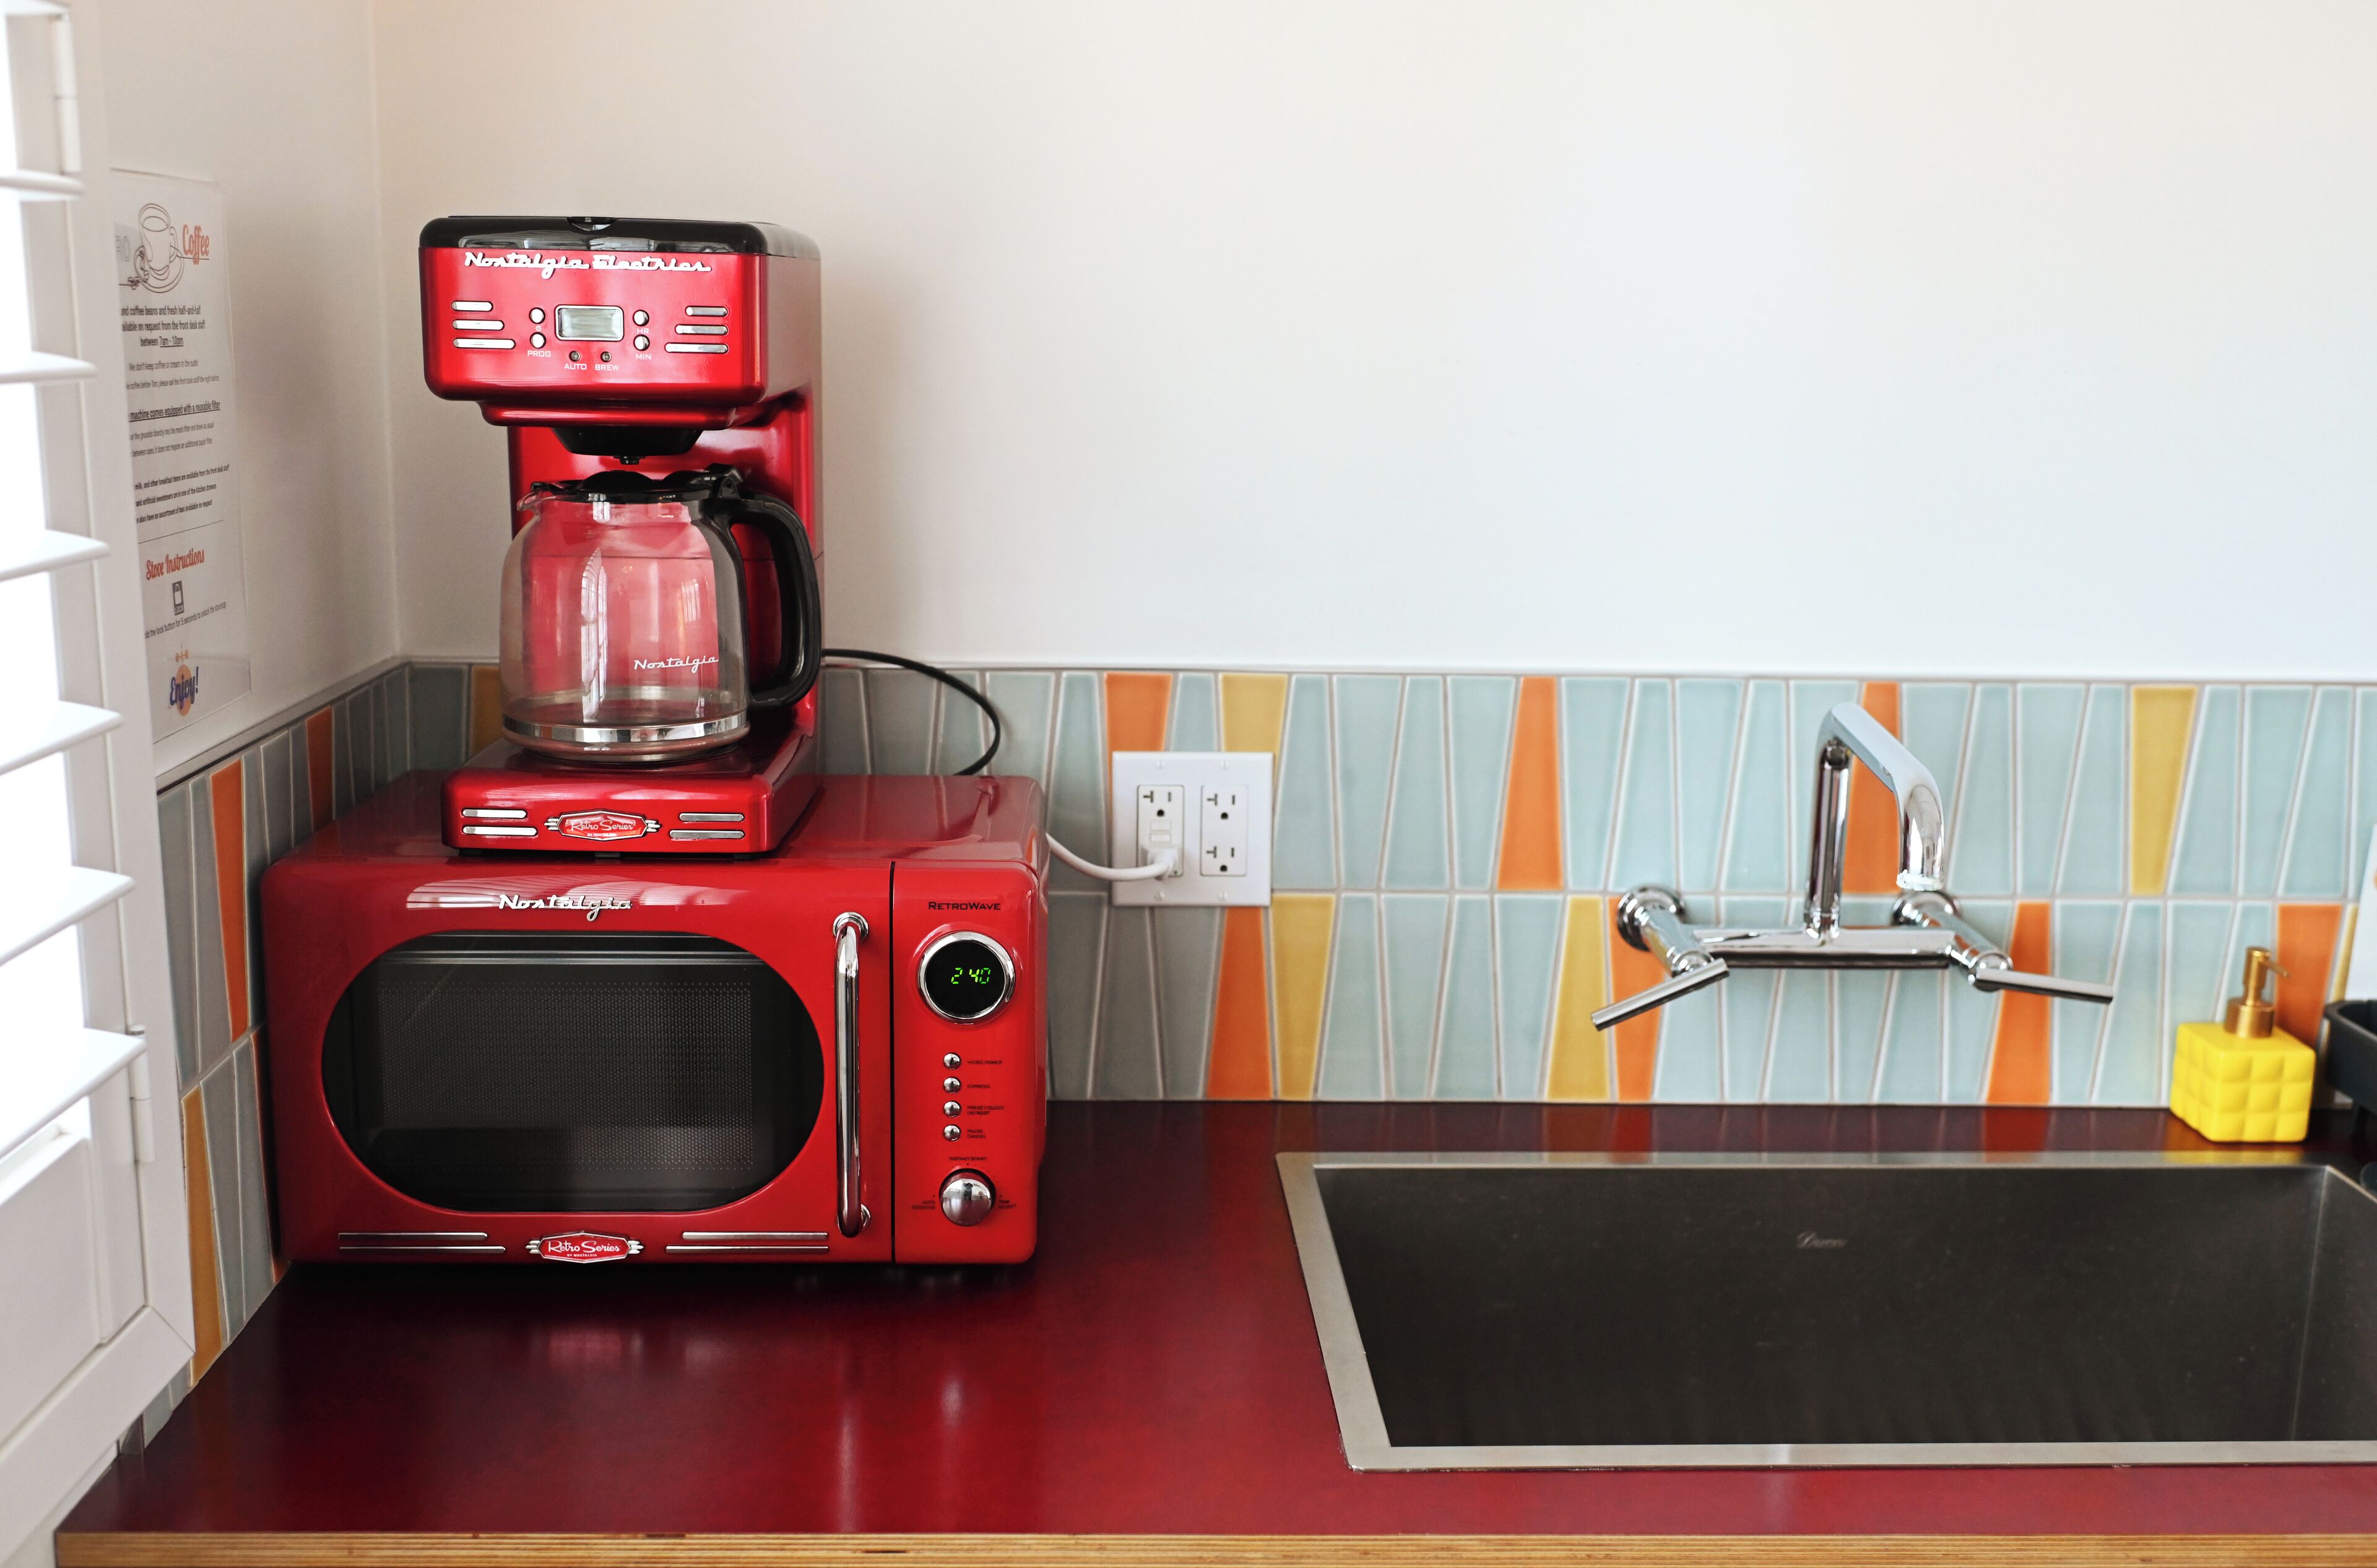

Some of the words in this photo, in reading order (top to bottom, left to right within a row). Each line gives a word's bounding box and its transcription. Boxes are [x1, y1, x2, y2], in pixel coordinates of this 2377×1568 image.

[183, 224, 209, 265] Coffee
[465, 252, 590, 279] Nostalgia
[592, 254, 712, 272] Electrics
[130, 305, 144, 316] coffee
[145, 305, 158, 316] beans
[167, 305, 178, 315] fresh
[145, 322, 160, 333] request
[162, 321, 171, 330] from
[180, 320, 188, 330] front
[189, 320, 197, 329] desk
[141, 337, 158, 347] between
[159, 336, 168, 346] 7am
[172, 336, 184, 346] 10pm
[131, 409, 149, 420] machine
[150, 409, 163, 418] comes
[165, 404, 183, 416] equipped
[183, 403, 192, 413] with
[196, 401, 211, 412] reusable
[212, 400, 220, 409] filter
[146, 560, 164, 581] Stove
[165, 548, 205, 574] Instructions
[634, 655, 719, 674] Nostalgia
[170, 666, 199, 710] Enjoy!
[571, 820, 599, 831] Retro
[599, 820, 633, 831] Series
[499, 894, 632, 921] Nostalgia
[547, 1240, 580, 1253] Retro
[581, 1241, 620, 1253] Series
